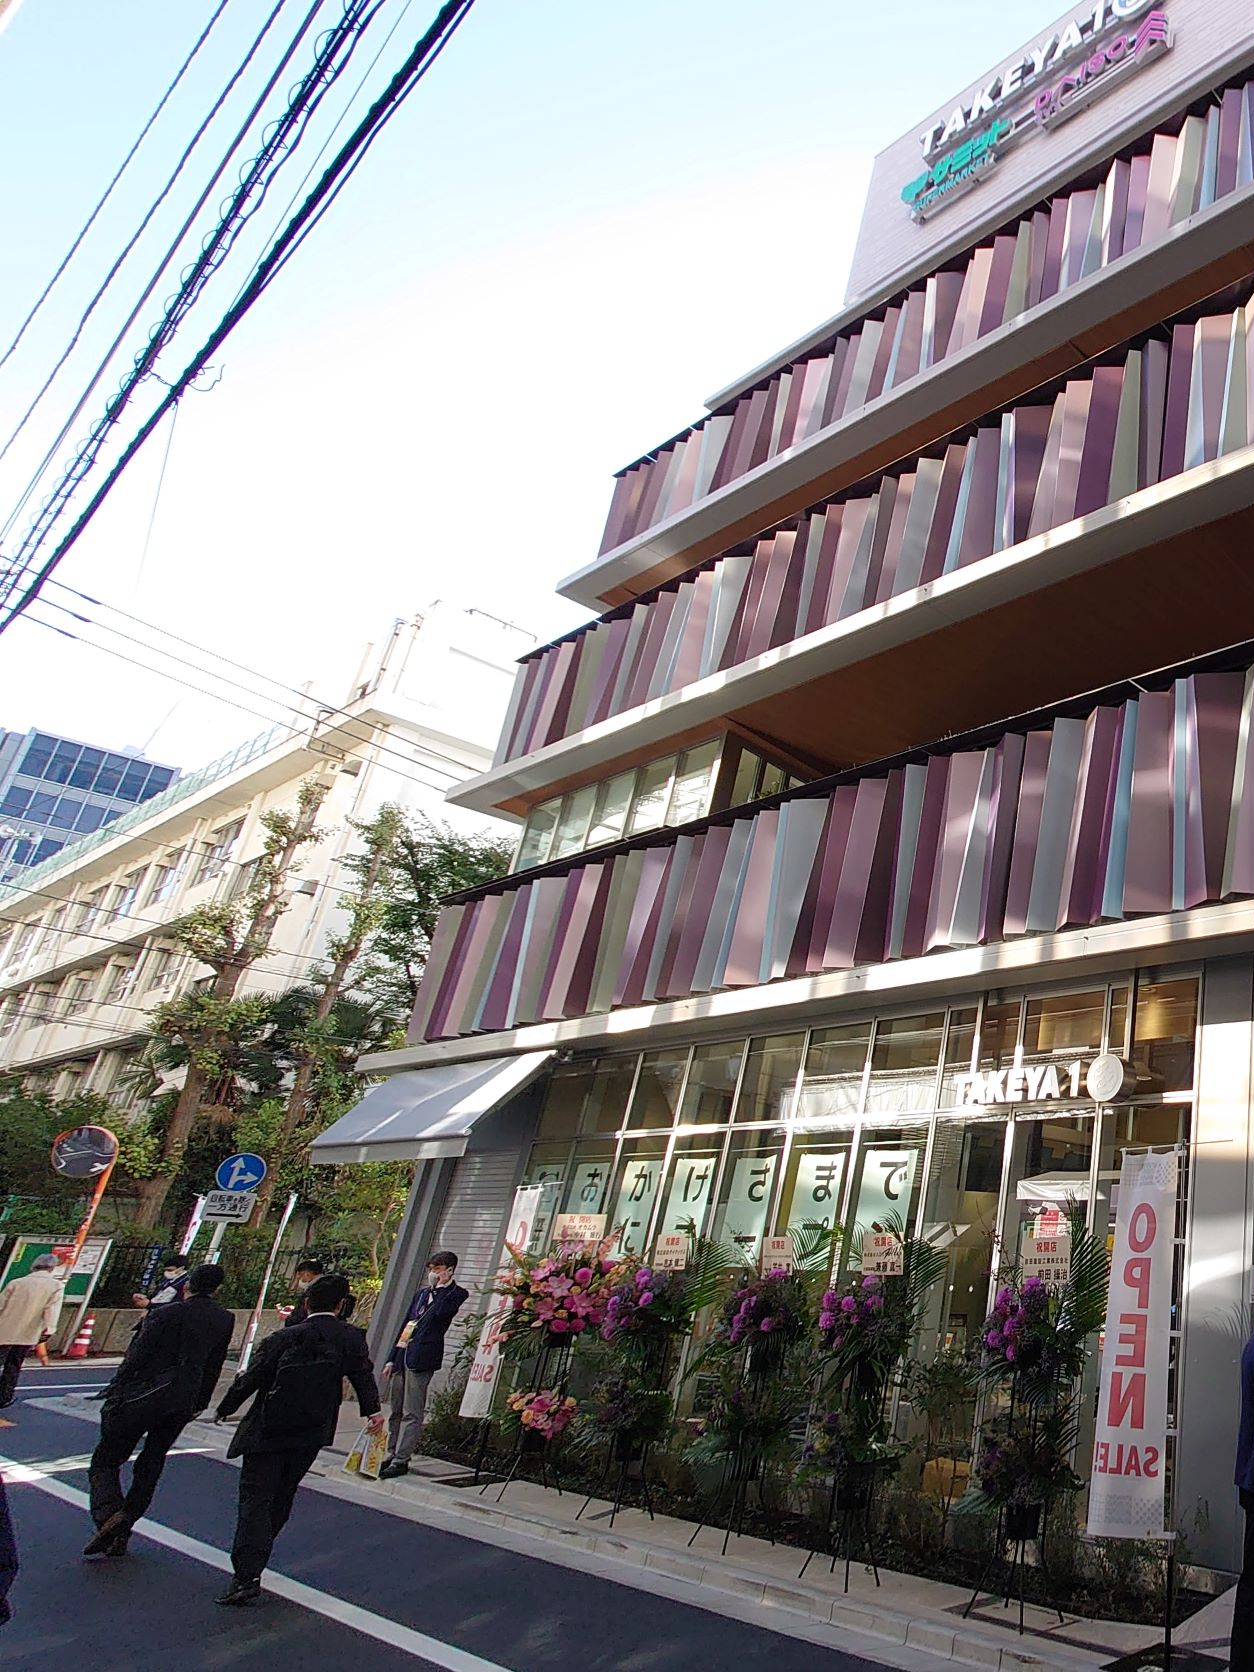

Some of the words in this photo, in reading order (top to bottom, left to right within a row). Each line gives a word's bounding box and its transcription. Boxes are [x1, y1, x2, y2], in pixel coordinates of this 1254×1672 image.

[919, 19, 1082, 158] TAKEYA
[953, 1065, 1060, 1106] TAKEYA
[208, 1203, 249, 1212] 一方通行
[1036, 1242, 1057, 1253] 祝開店
